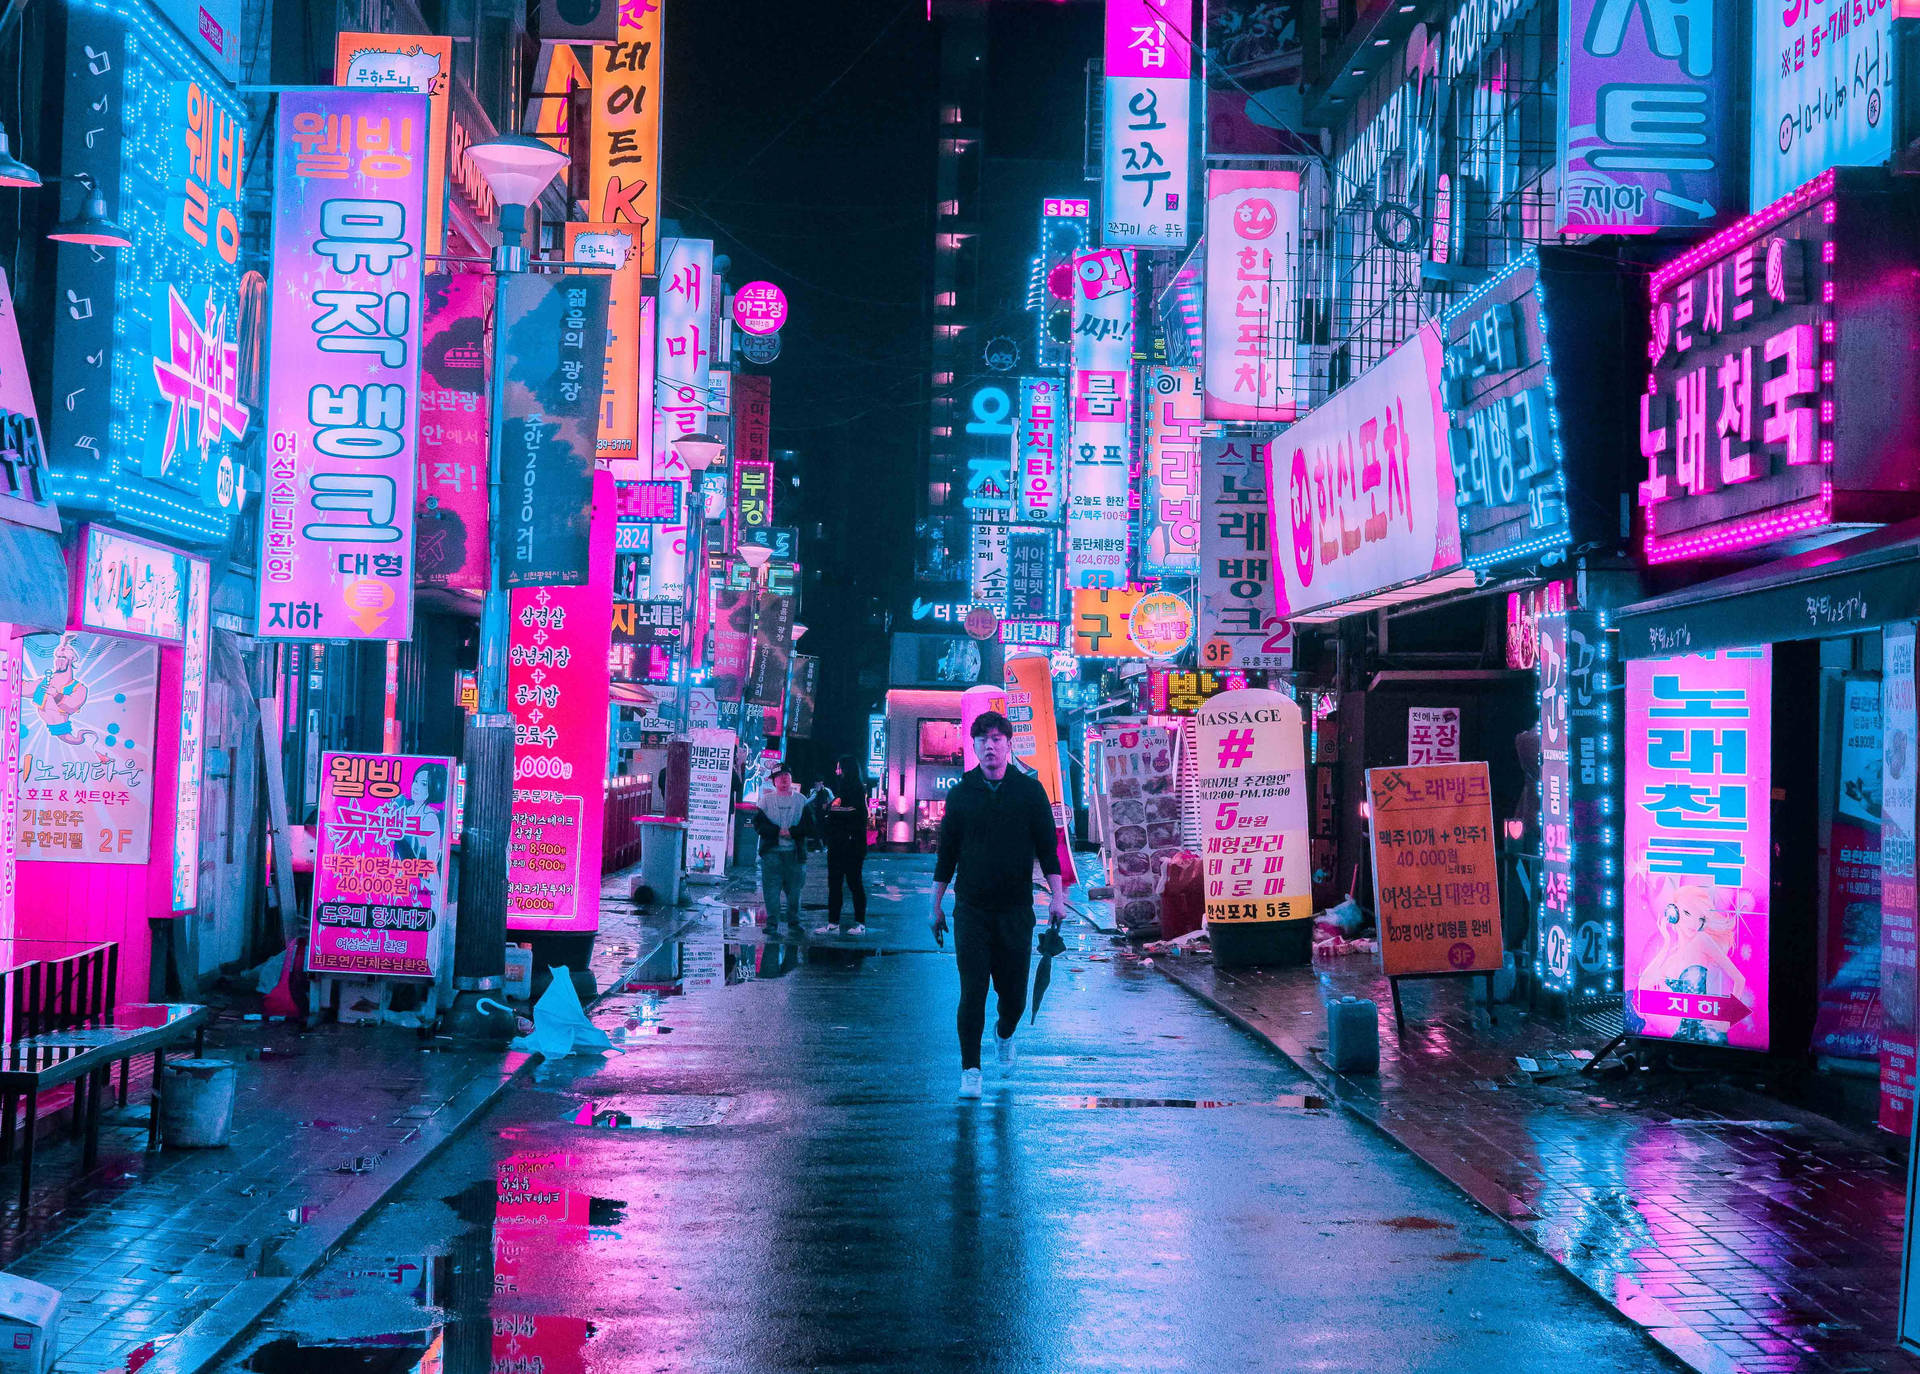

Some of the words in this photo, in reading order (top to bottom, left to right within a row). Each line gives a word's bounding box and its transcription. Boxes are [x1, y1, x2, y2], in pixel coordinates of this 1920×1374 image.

[1127, 20, 1167, 68] 집
[292, 112, 412, 179] 웰빙
[1046, 199, 1087, 216] sbs
[1581, 184, 1646, 216] 지하
[1107, 222, 1140, 236] 쭈꾸미
[1164, 223, 1184, 237] 퐁듀
[579, 242, 614, 257] 무한도니
[744, 288, 777, 300] 스크린
[1675, 247, 1754, 353] 콘서트
[564, 288, 587, 349] 젊음의
[737, 300, 784, 319] 야구장
[1235, 246, 1272, 397] 한신포차
[302, 198, 414, 544] 뮤직뱅크
[560, 360, 583, 402] 광장
[1082, 374, 1120, 415] 룸
[1638, 325, 1818, 507] 노래천국
[1024, 405, 1055, 507] 뮤직타운
[1075, 443, 1123, 466] 호프
[1313, 395, 1413, 566] 한신포차
[268, 432, 297, 583] 여성손님환영
[742, 471, 766, 525] 부킹
[1074, 496, 1102, 506] 오늘도
[1106, 496, 1124, 507] 한잔
[1033, 509, 1046, 518] B1
[616, 527, 650, 549] 2824
[1071, 538, 1125, 553] 룸단체환영
[338, 552, 403, 578] 대형
[1075, 553, 1121, 565] 424.6789
[1213, 475, 1270, 637] 노래뱅크
[1012, 545, 1029, 610] 세계맥주
[268, 600, 323, 631] 지하
[519, 606, 566, 630] 삼겹살
[934, 603, 950, 622] 더
[1261, 617, 1291, 654] 2
[511, 646, 570, 669] 양념게장
[1206, 644, 1231, 662] 3F
[515, 685, 560, 708] 공기밥
[1197, 709, 1282, 727] MASSAGE
[514, 724, 558, 747] 음료수
[1105, 738, 1118, 748] 2F
[1410, 725, 1458, 748] 포장
[181, 739, 195, 761] HOF
[330, 757, 403, 799] 웰빙
[513, 755, 573, 780] ,000원
[936, 777, 962, 789] HO
[1403, 776, 1489, 804] 노래뱅크
[1641, 674, 1750, 888] 노래천국
[28, 788, 54, 802] 호프
[59, 789, 69, 802] &
[73, 789, 130, 806] 셋트안주
[22, 809, 84, 827] 기본안주
[324, 805, 435, 849] 뮤직뱅크
[1215, 801, 1269, 831] 5만원
[21, 831, 84, 850] 무한리필
[99, 828, 134, 853] 2F
[515, 826, 543, 841] 삼겹살
[1207, 834, 1285, 855] 체형관리
[1378, 828, 1435, 847] 맥주10개
[1453, 825, 1487, 844] 안주1
[529, 843, 567, 857] 8,900원
[322, 855, 435, 878] 맥주10병+안주
[528, 859, 566, 872] 6,900원
[337, 876, 409, 895] 40,000원
[1382, 884, 1442, 909] 여성손님
[1445, 881, 1491, 906] 대환영
[516, 898, 554, 911] 7,000원
[1207, 903, 1258, 921] 한신포차
[1266, 902, 1292, 918] 5층
[321, 905, 367, 927] 도우미
[372, 907, 433, 931] 항시대기
[1389, 925, 1412, 942] 20명
[1414, 923, 1434, 940] 이상
[1437, 920, 1468, 938] 대형룸
[1470, 918, 1492, 937] 완비
[336, 937, 381, 953] 여성손님
[384, 938, 408, 954] 환영
[1551, 929, 1565, 971] 2F
[314, 954, 429, 974] 피로연/단체손님환영
[1666, 998, 1721, 1018] 지하
